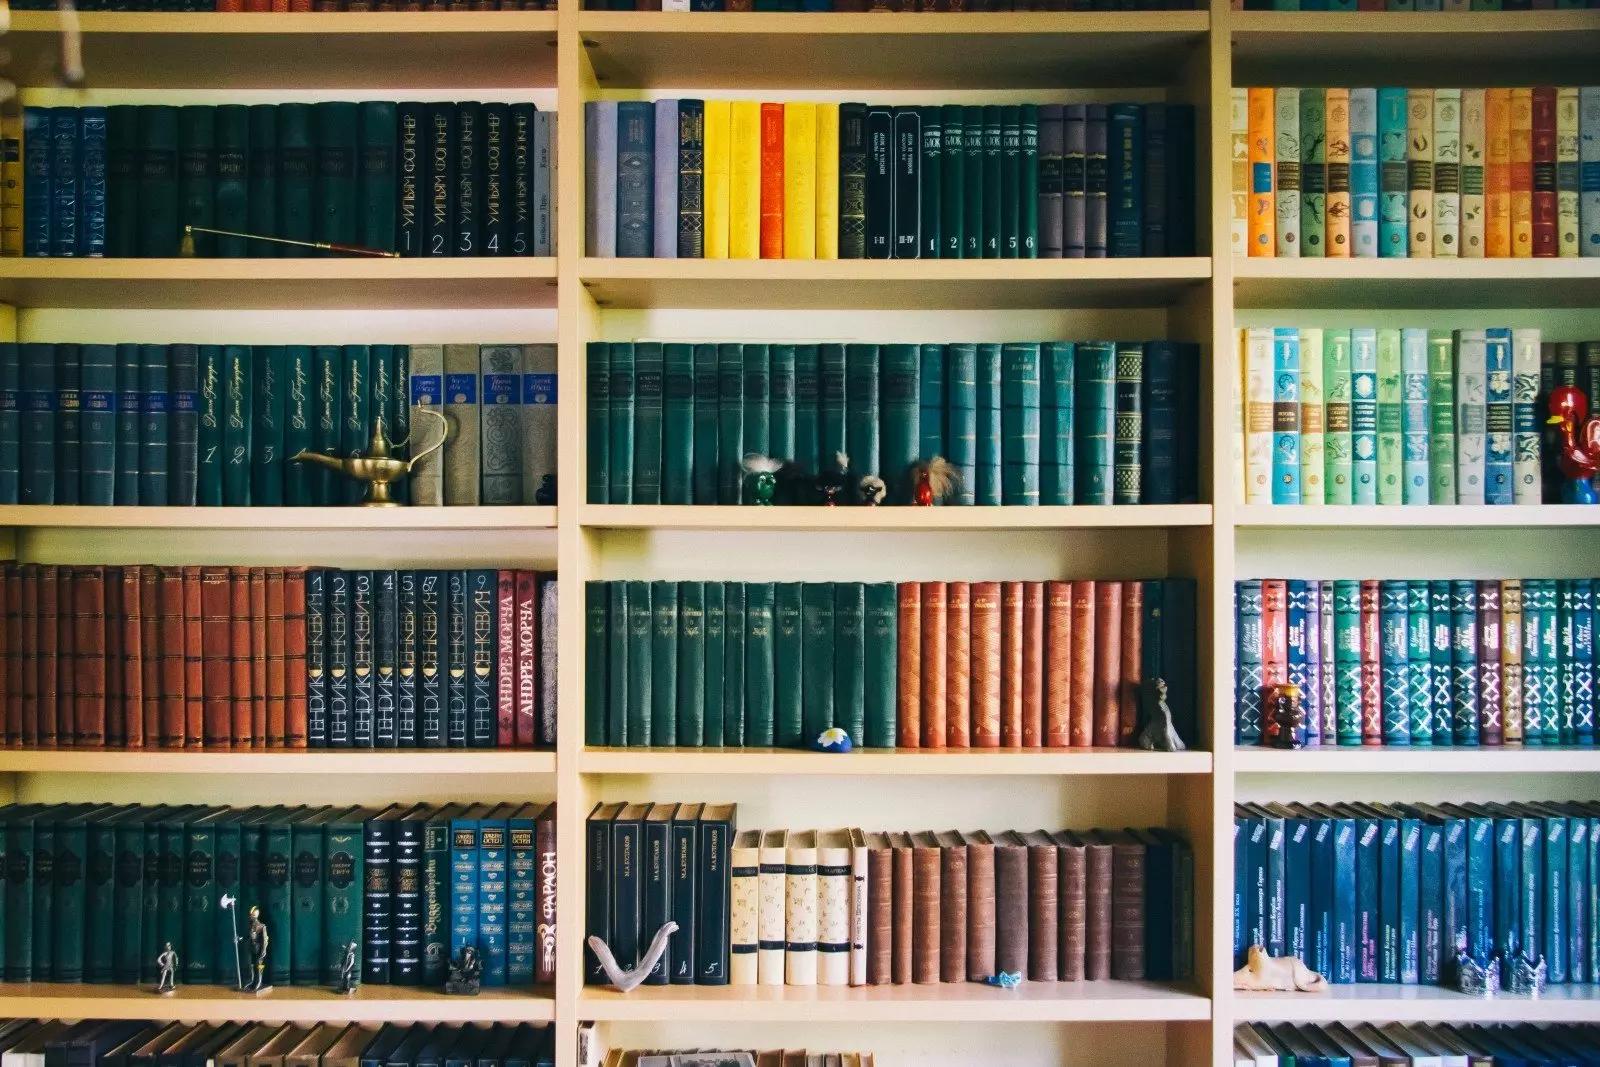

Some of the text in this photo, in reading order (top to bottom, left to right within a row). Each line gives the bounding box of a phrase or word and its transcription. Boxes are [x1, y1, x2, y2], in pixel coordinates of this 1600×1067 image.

[924, 137, 941, 148] БЛОК
[945, 136, 962, 146] БЛОК
[965, 137, 981, 147] БЛОК
[985, 137, 1000, 146] БЛОК
[1004, 136, 1020, 147] БЛОК
[1022, 136, 1038, 146] БЛОК
[403, 113, 416, 227] УИЛЬЯМ ФОЛКНЕР
[434, 114, 448, 225] УИЛЬЯМ ФОЛКНЕР
[461, 112, 473, 224] УИЛЬЯМ ФОЛКНЕР
[488, 113, 500, 225] УИЛЬЯМ ФОЛКНЕР
[516, 115, 528, 223] УИЛЬЯМ ФОЛКНЕР
[433, 234, 444, 254] 2
[461, 232, 472, 251] 3
[488, 233, 498, 252] 4
[513, 232, 525, 253] 5
[929, 239, 935, 251] 1
[950, 237, 957, 248] 2
[969, 238, 976, 248] 3
[989, 238, 996, 248] 4
[1009, 237, 1016, 248] 5
[1025, 238, 1033, 248] 6
[202, 446, 218, 464] 1
[230, 446, 246, 464] 2
[263, 446, 274, 464] 3
[312, 576, 323, 591] 1
[333, 578, 345, 593] 2
[357, 576, 370, 591] 3
[383, 575, 394, 590] 4
[402, 576, 414, 591] 5
[450, 577, 460, 591] 8
[477, 575, 487, 590] 9
[500, 596, 513, 714] АНДРЕ МОРУА
[520, 599, 534, 717] АНДРЕ МОРУА
[309, 591, 324, 741] ГЕНРИК СЕНКЕВИЧ
[330, 592, 346, 742] ГЕНРИК СЕНКЕВИЧ
[355, 591, 370, 741] ГЕНРИК СЕНКЕВИЧ
[400, 591, 415, 741] ГЕНРИК СЕНКЕВИЧ
[422, 591, 440, 741] ГЕНРИК СЕНКЕВИЧ
[449, 591, 465, 741] ГЕНРИК СЕНКЕВИЧ
[474, 590, 491, 740] ГЕНРИК СЕНКЕВИЧ
[378, 672, 394, 739] ГЕНРИК
[542, 852, 556, 919] ФАРАОН
[462, 936, 466, 944] 1
[489, 936, 495, 944] 2
[679, 963, 688, 974] 4
[705, 962, 718, 974] 5
